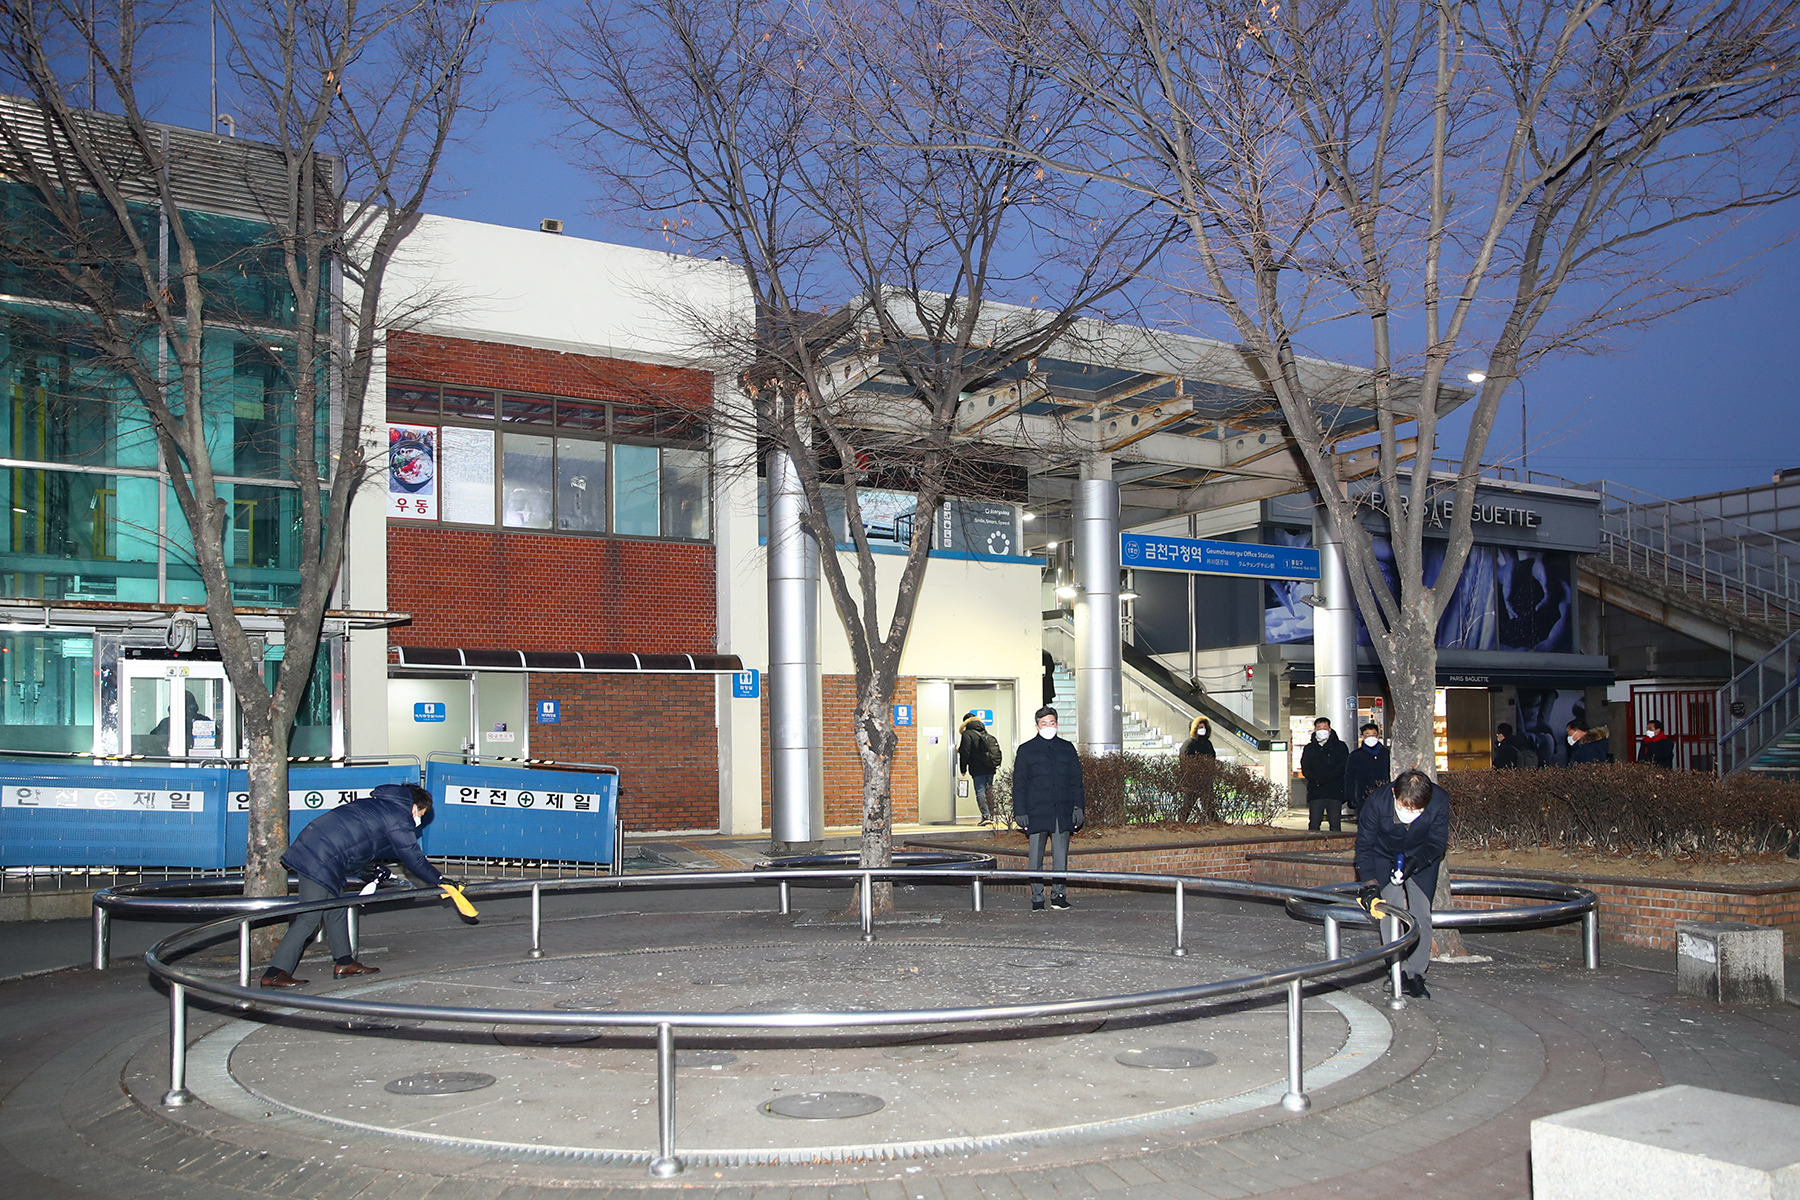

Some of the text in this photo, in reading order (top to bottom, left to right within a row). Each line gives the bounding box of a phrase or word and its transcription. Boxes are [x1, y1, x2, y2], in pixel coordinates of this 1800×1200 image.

[395, 497, 429, 514] 우동
[1443, 499, 1537, 528] BGUETTE
[1145, 542, 1202, 563] 금천구청역
[1206, 547, 1243, 558] Geumcheon-gu
[133, 791, 193, 810] 제일
[459, 787, 591, 811] 안전 제일
